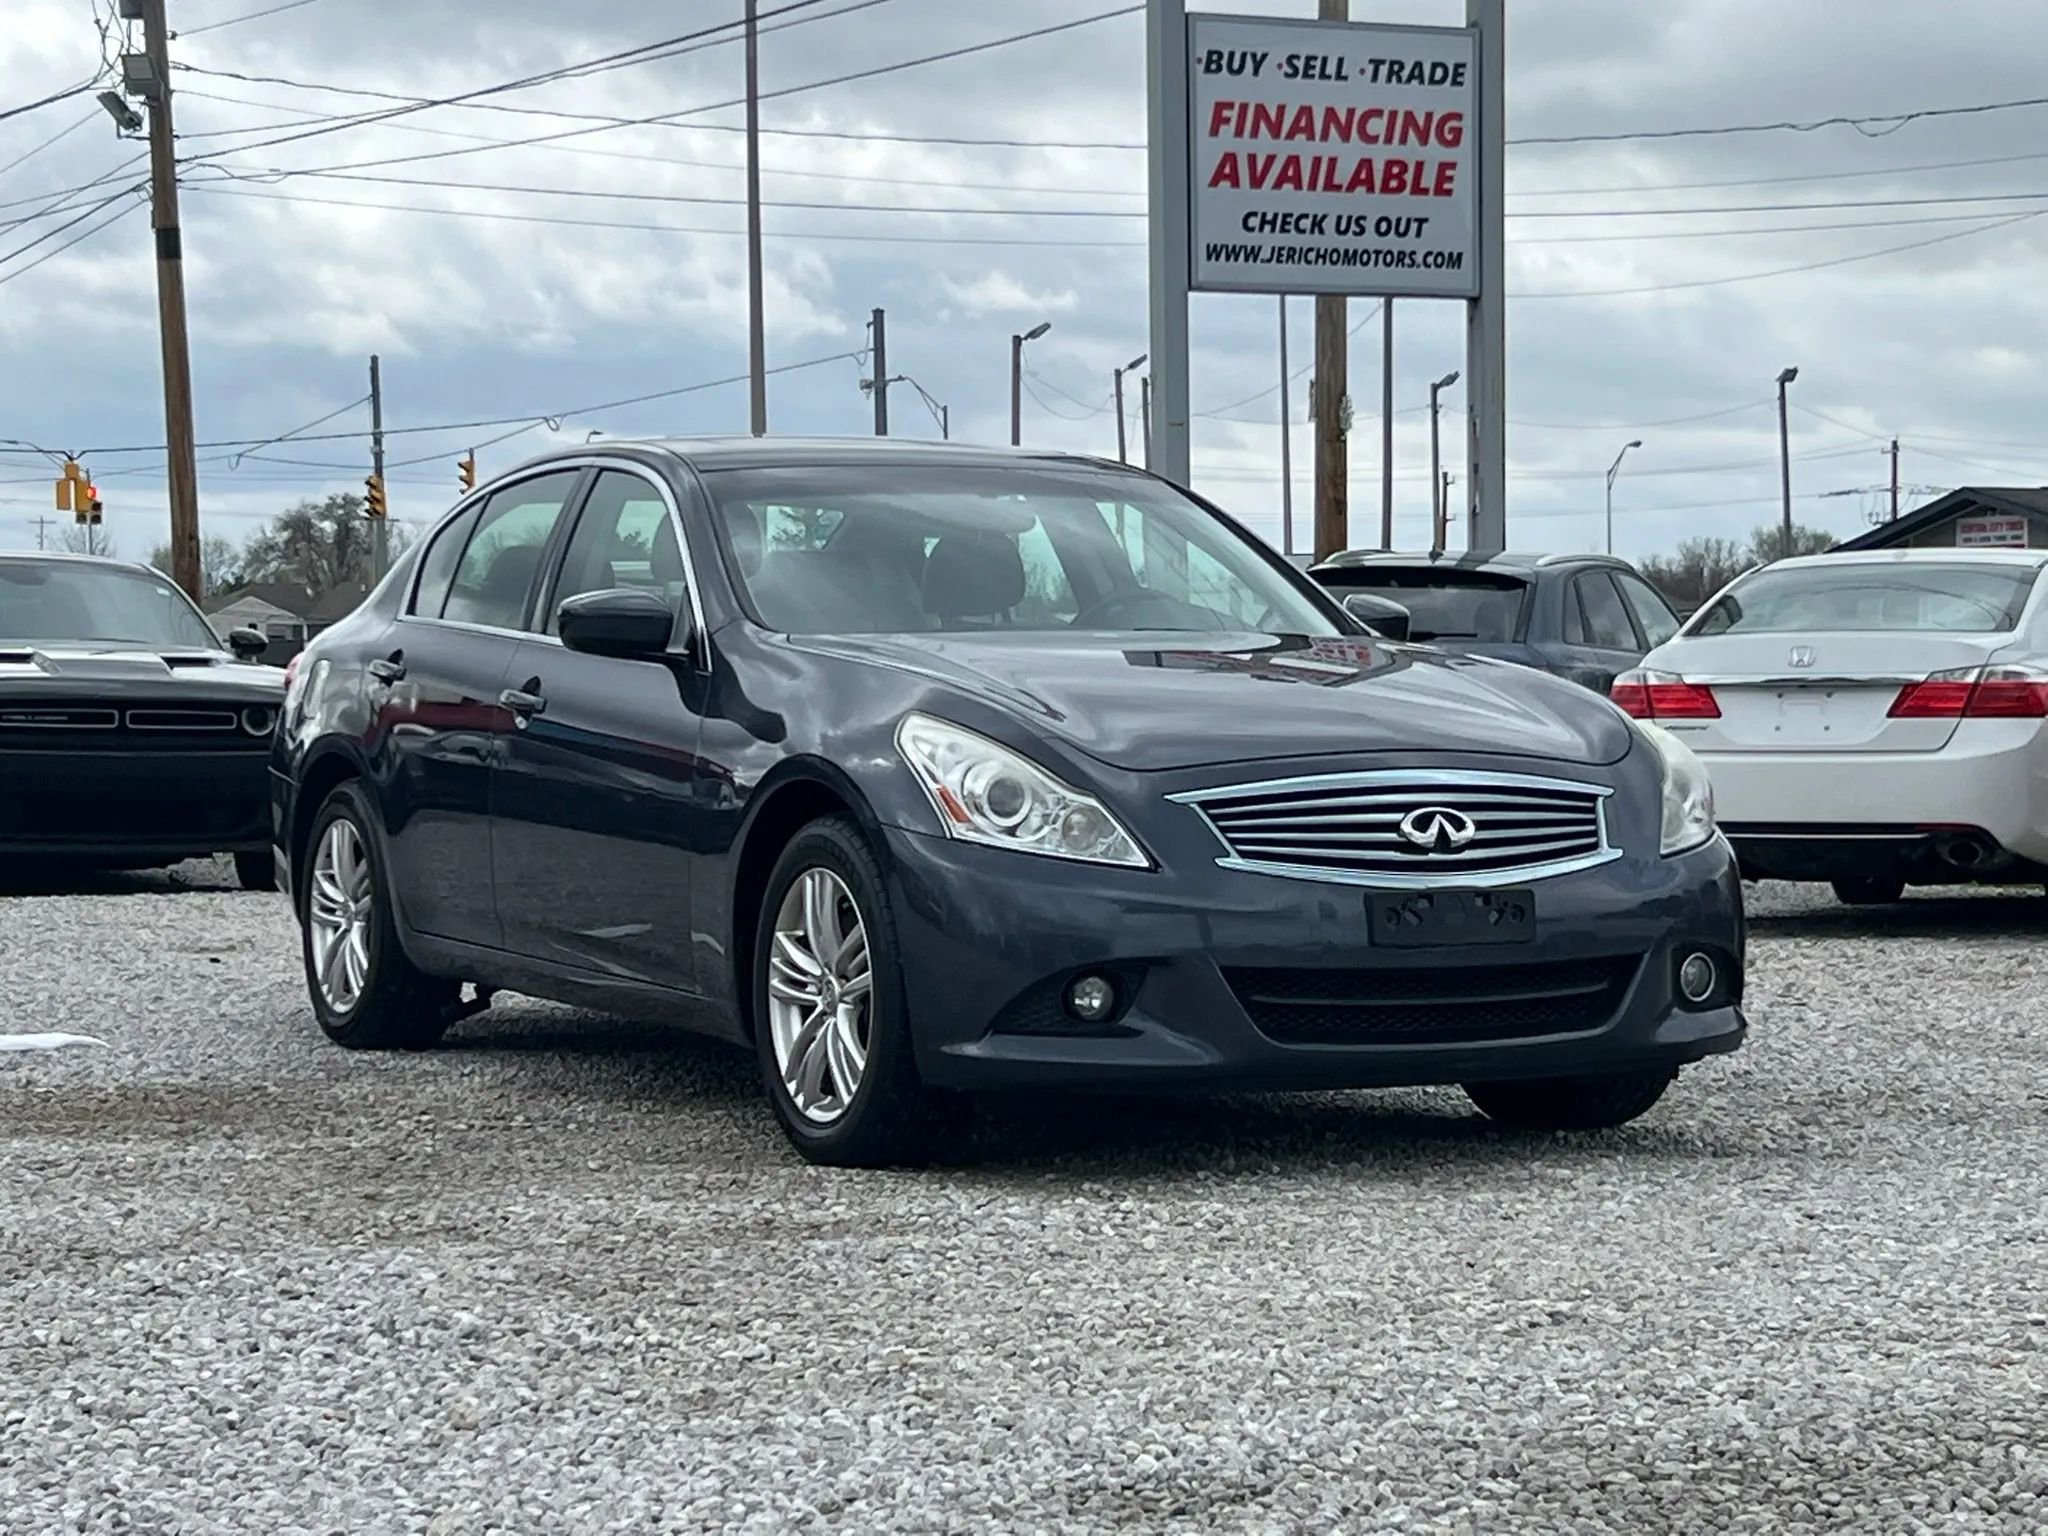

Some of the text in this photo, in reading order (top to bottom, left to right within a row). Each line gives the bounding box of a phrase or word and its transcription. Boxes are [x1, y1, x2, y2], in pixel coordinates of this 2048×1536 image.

[1202, 49, 1467, 87] BUY SELL TRADE
[1208, 101, 1464, 149] FINANCING
[1207, 151, 1458, 197] AVAILABLE
[1241, 211, 1429, 239] CHECK US OUT
[1205, 243, 1464, 270] WWW.JERICHOMOTORS.COM
